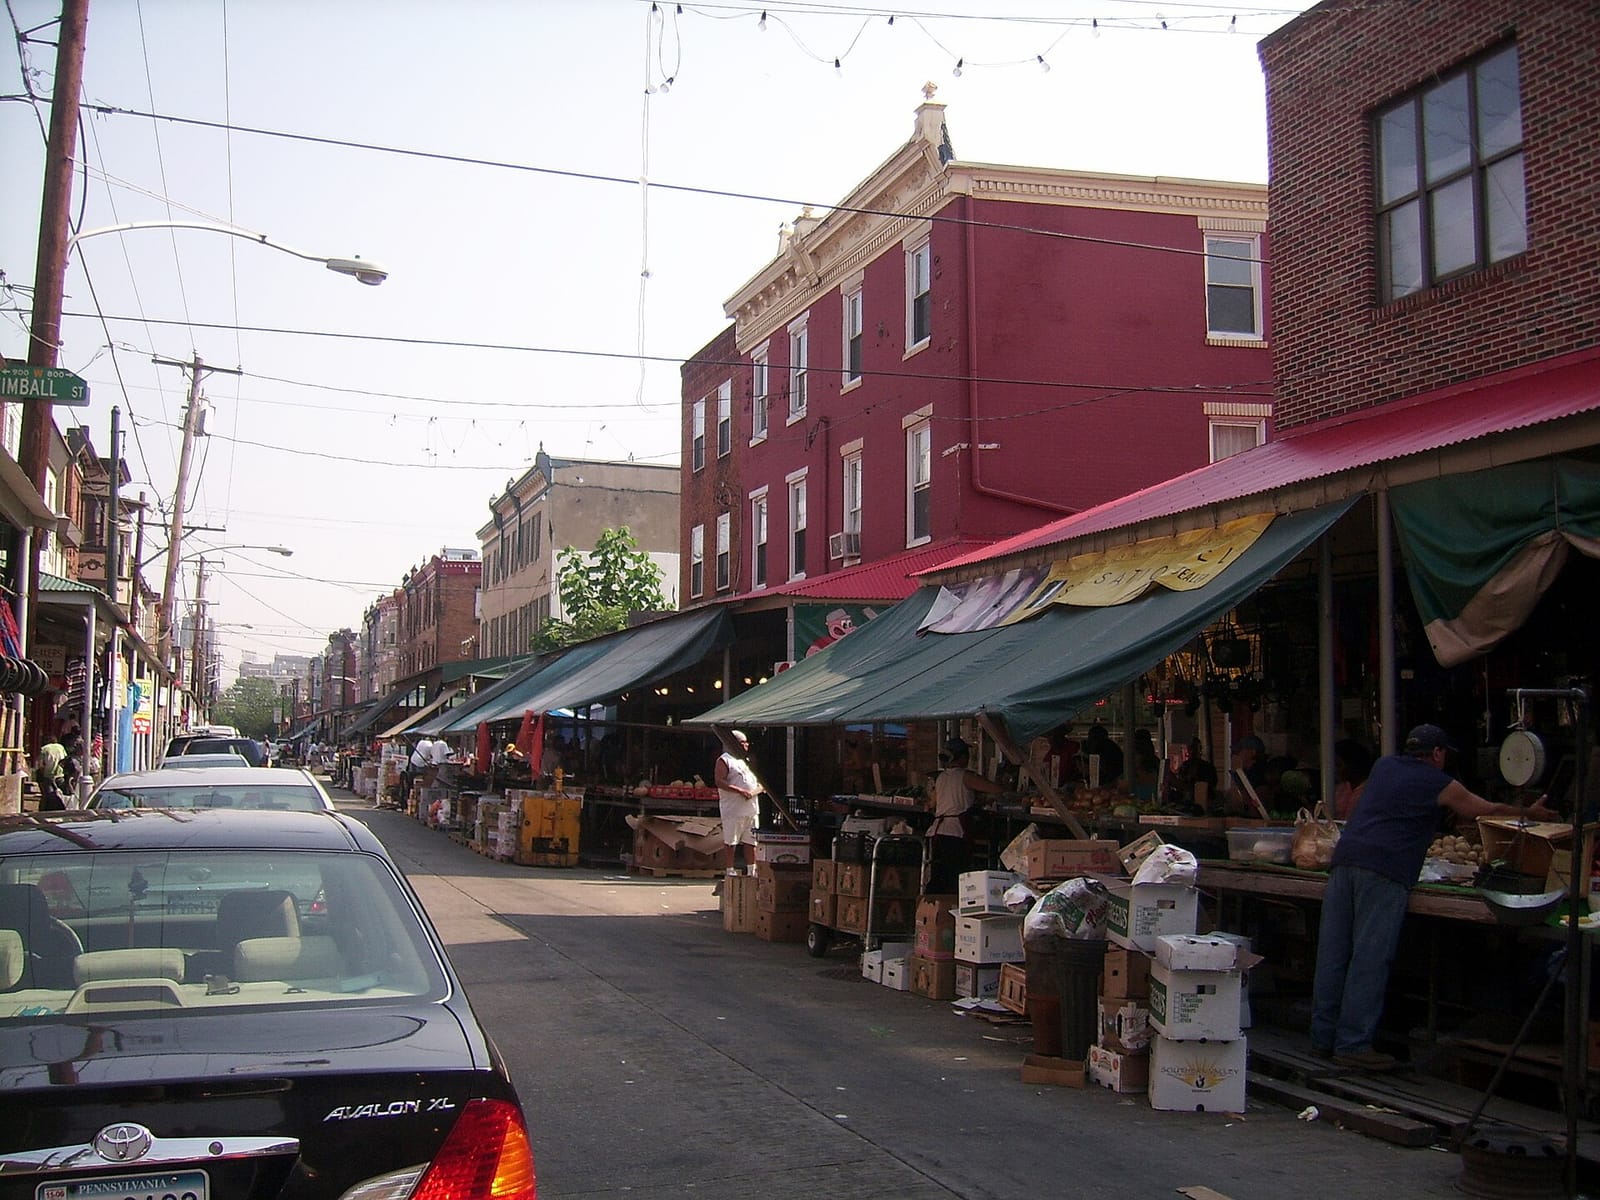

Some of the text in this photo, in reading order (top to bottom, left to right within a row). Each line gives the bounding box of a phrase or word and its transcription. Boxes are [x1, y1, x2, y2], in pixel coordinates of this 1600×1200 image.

[1, 377, 84, 398] IMBALL ST
[323, 1098, 455, 1121] AVALON XL
[79, 1178, 167, 1195] PENNSYLVANIA
